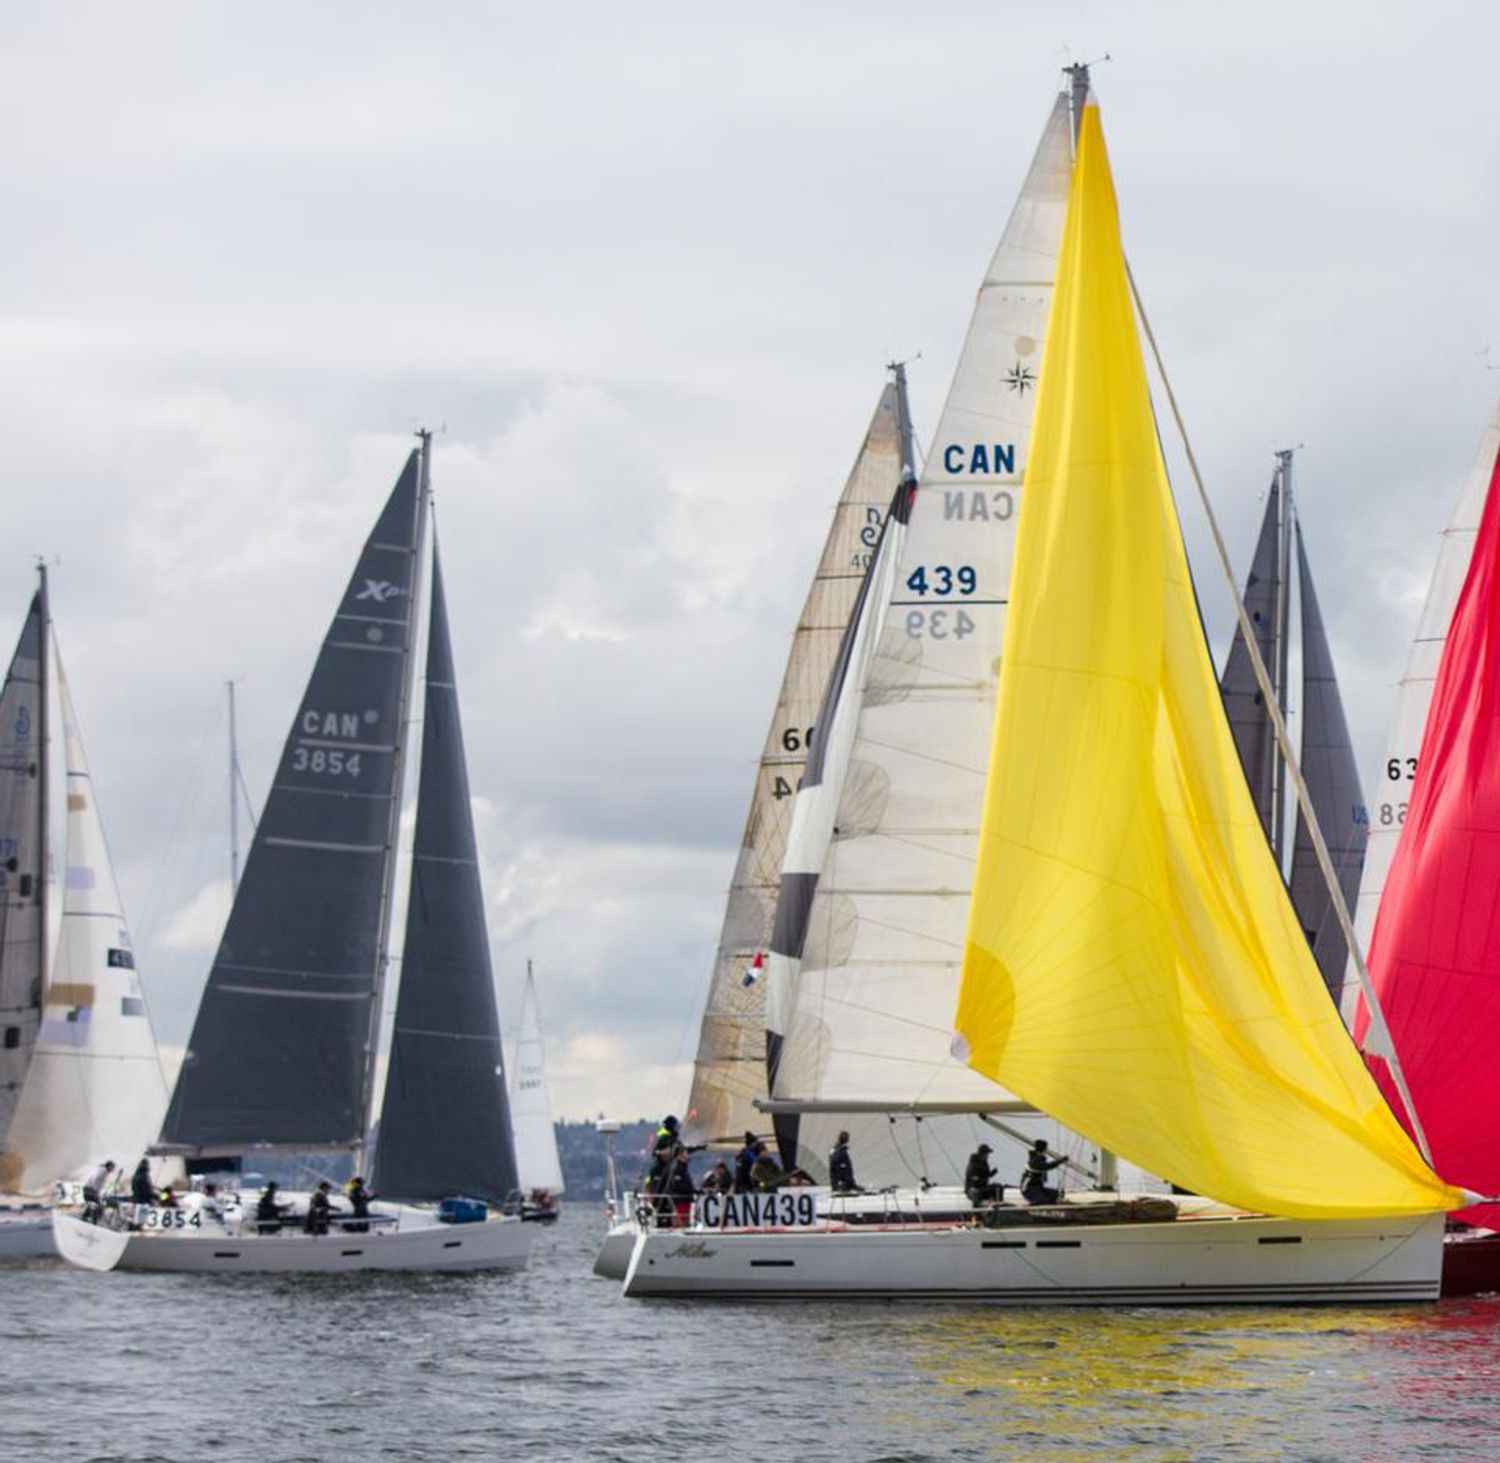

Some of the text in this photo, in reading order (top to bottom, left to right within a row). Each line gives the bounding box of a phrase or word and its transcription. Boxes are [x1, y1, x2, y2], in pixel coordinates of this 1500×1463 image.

[944, 444, 1015, 474] CAN
[906, 565, 976, 595] 439
[302, 709, 359, 738] CAN
[292, 747, 362, 777] 3854
[149, 1210, 202, 1231] 3854
[703, 1194, 814, 1227] CAN439
